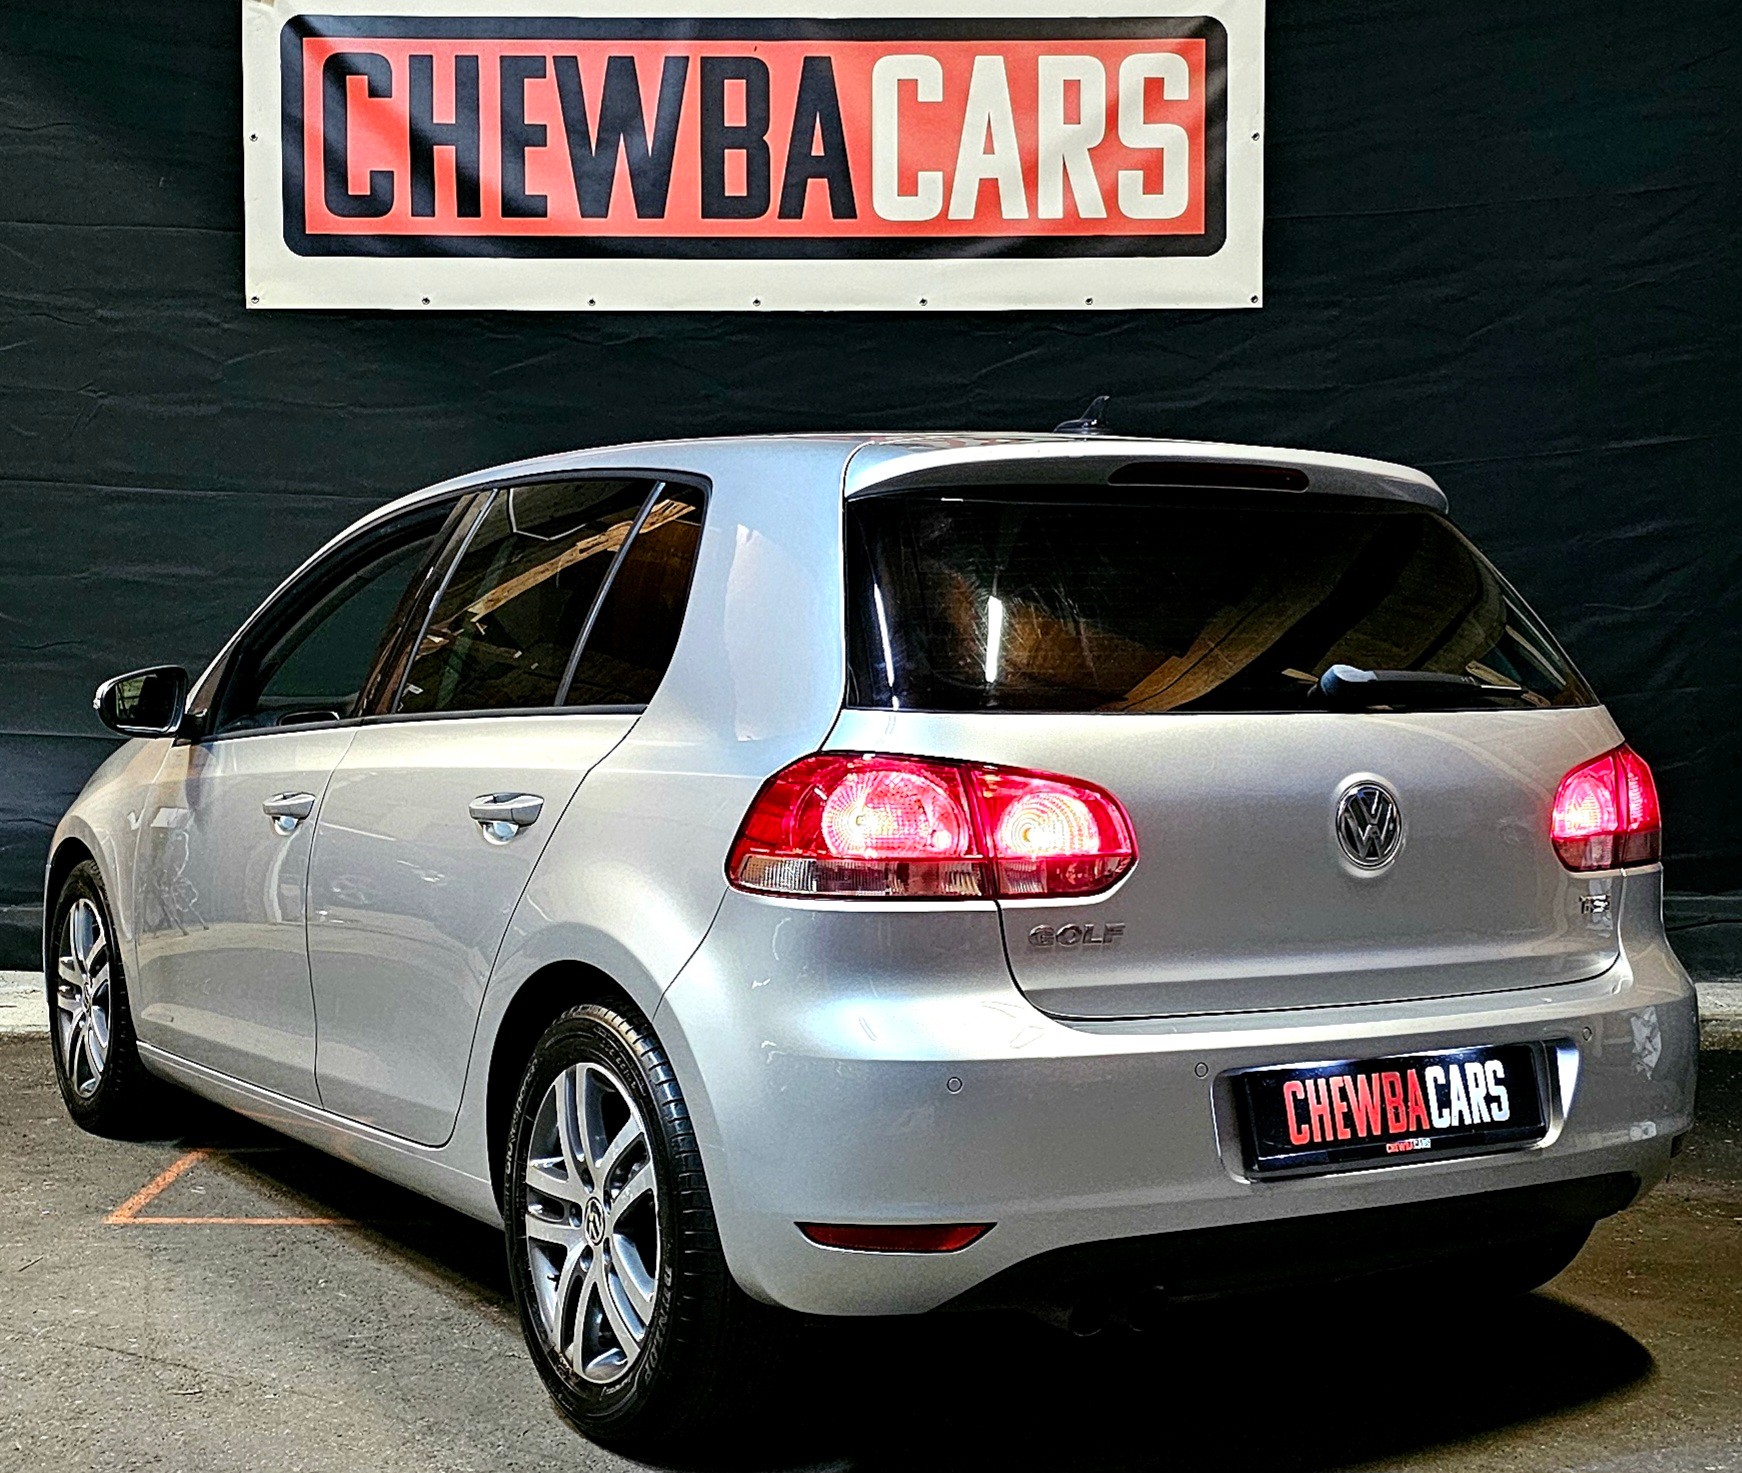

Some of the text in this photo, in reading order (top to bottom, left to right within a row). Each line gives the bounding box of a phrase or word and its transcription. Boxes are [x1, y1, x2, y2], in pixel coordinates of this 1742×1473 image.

[320, 51, 1191, 222] CHEWBACARS
[1027, 922, 1126, 947] GOLF
[1283, 1059, 1511, 1146] CHEWBACARS
